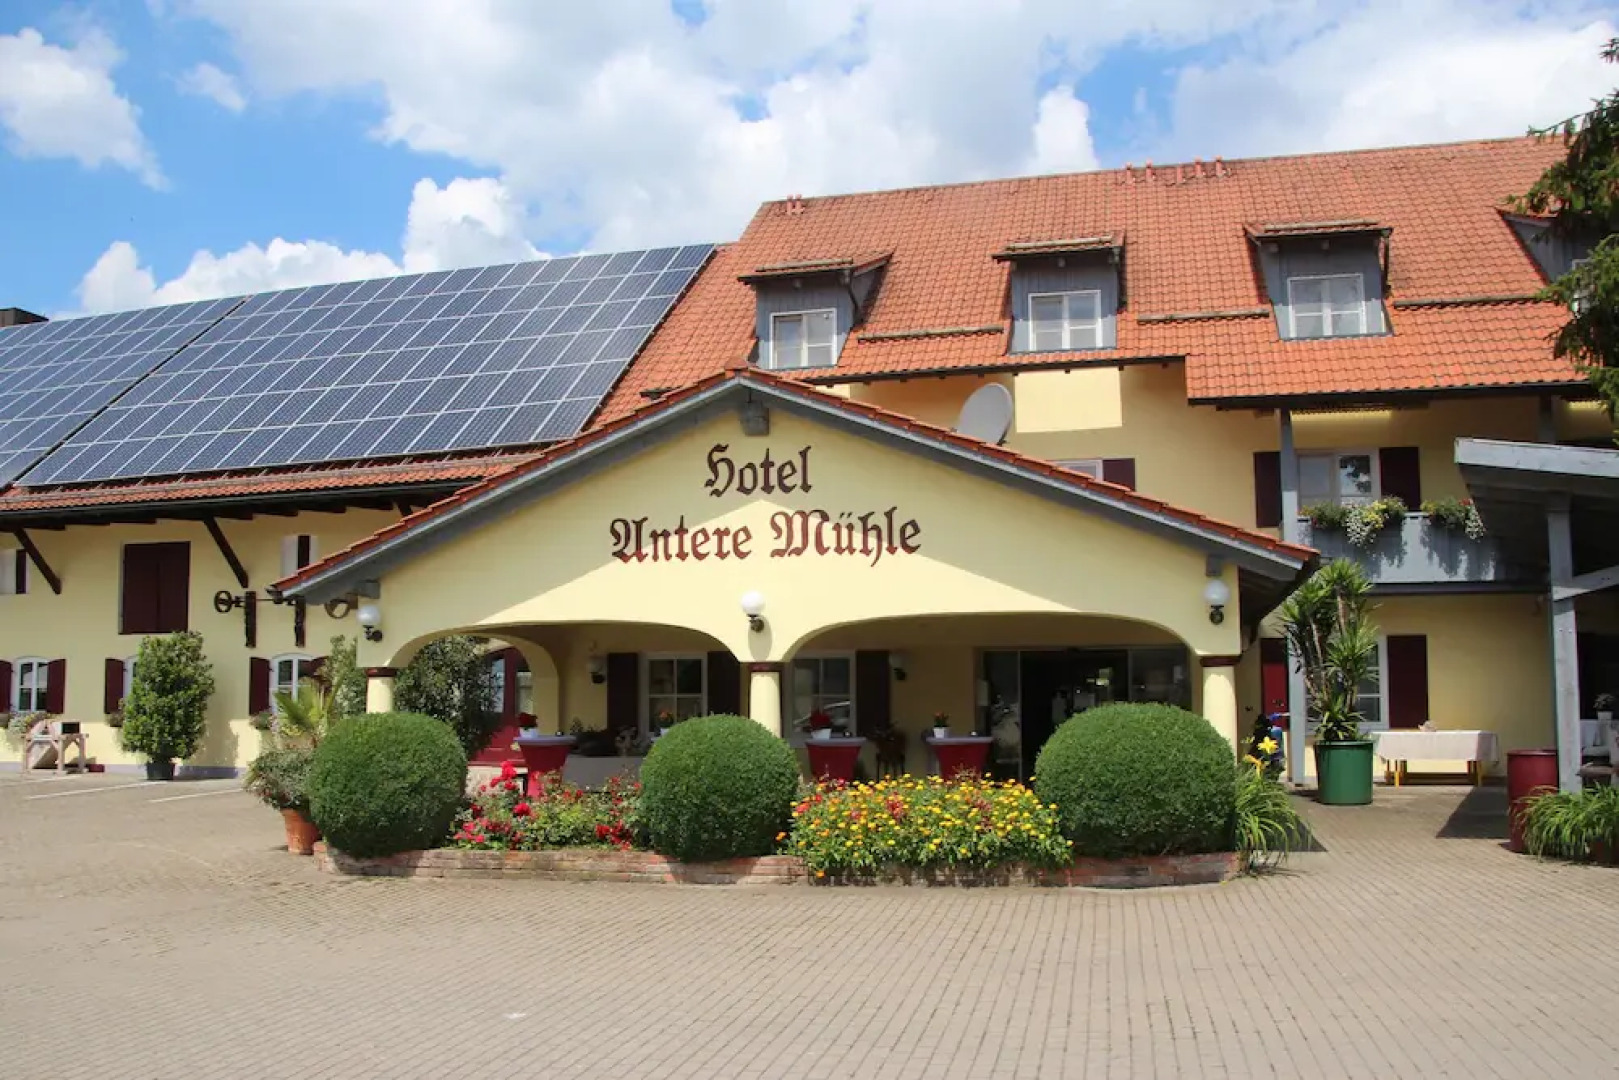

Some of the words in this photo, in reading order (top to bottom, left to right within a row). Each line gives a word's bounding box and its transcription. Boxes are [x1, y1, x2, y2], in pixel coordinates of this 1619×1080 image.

[704, 443, 812, 497] Hotel
[610, 515, 752, 563] Untere
[770, 507, 921, 567] Mühle
